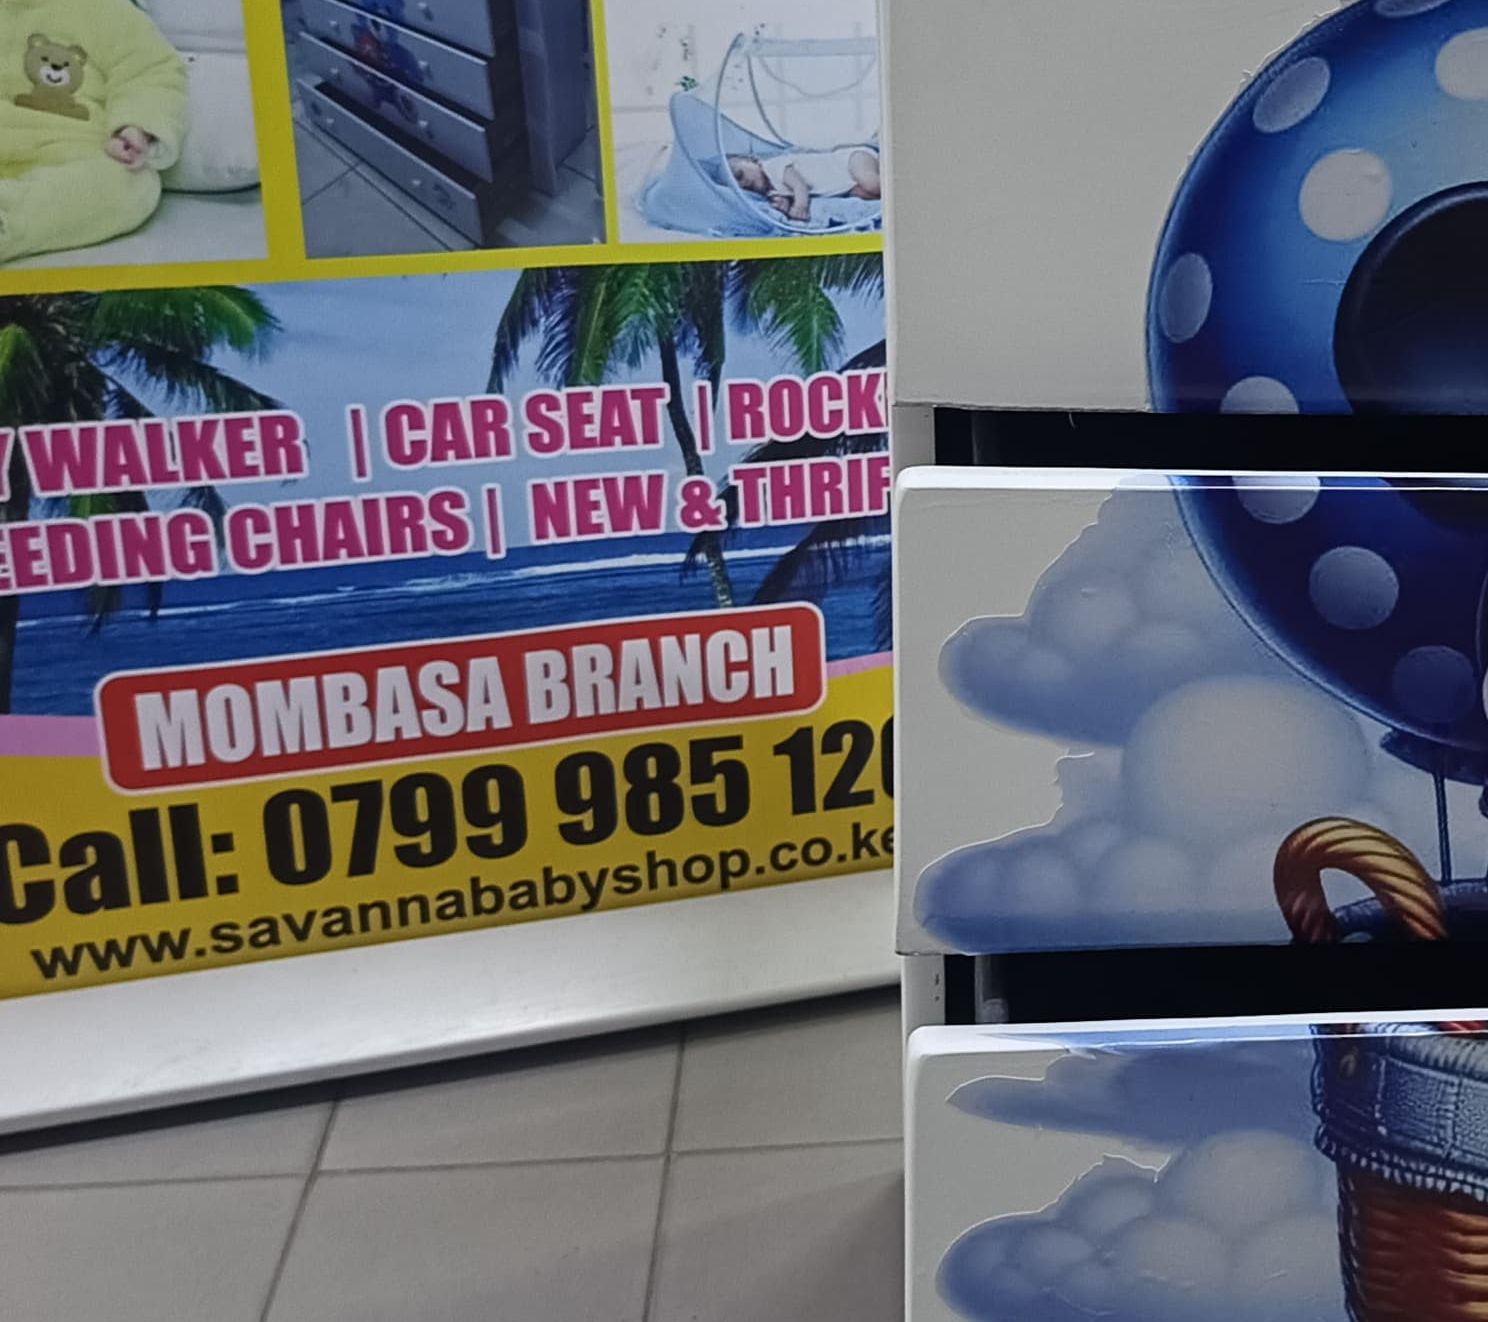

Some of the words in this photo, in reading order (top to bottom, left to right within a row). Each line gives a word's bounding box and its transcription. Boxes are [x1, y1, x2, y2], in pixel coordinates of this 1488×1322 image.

[22, 412, 306, 495] WALKER
[383, 397, 513, 467] CAR
[523, 385, 667, 456] SEAT
[727, 372, 888, 442] ROCK
[227, 489, 471, 570] CHAIRS
[531, 474, 666, 542] NEW
[679, 479, 723, 529] &
[731, 455, 891, 525] THRIF
[134, 656, 513, 770] MOMBASA
[524, 625, 795, 725] BRANCH
[0, 802, 240, 925] Call:
[262, 763, 528, 887] 0799
[554, 734, 751, 847] 985
[772, 719, 895, 816] 12
